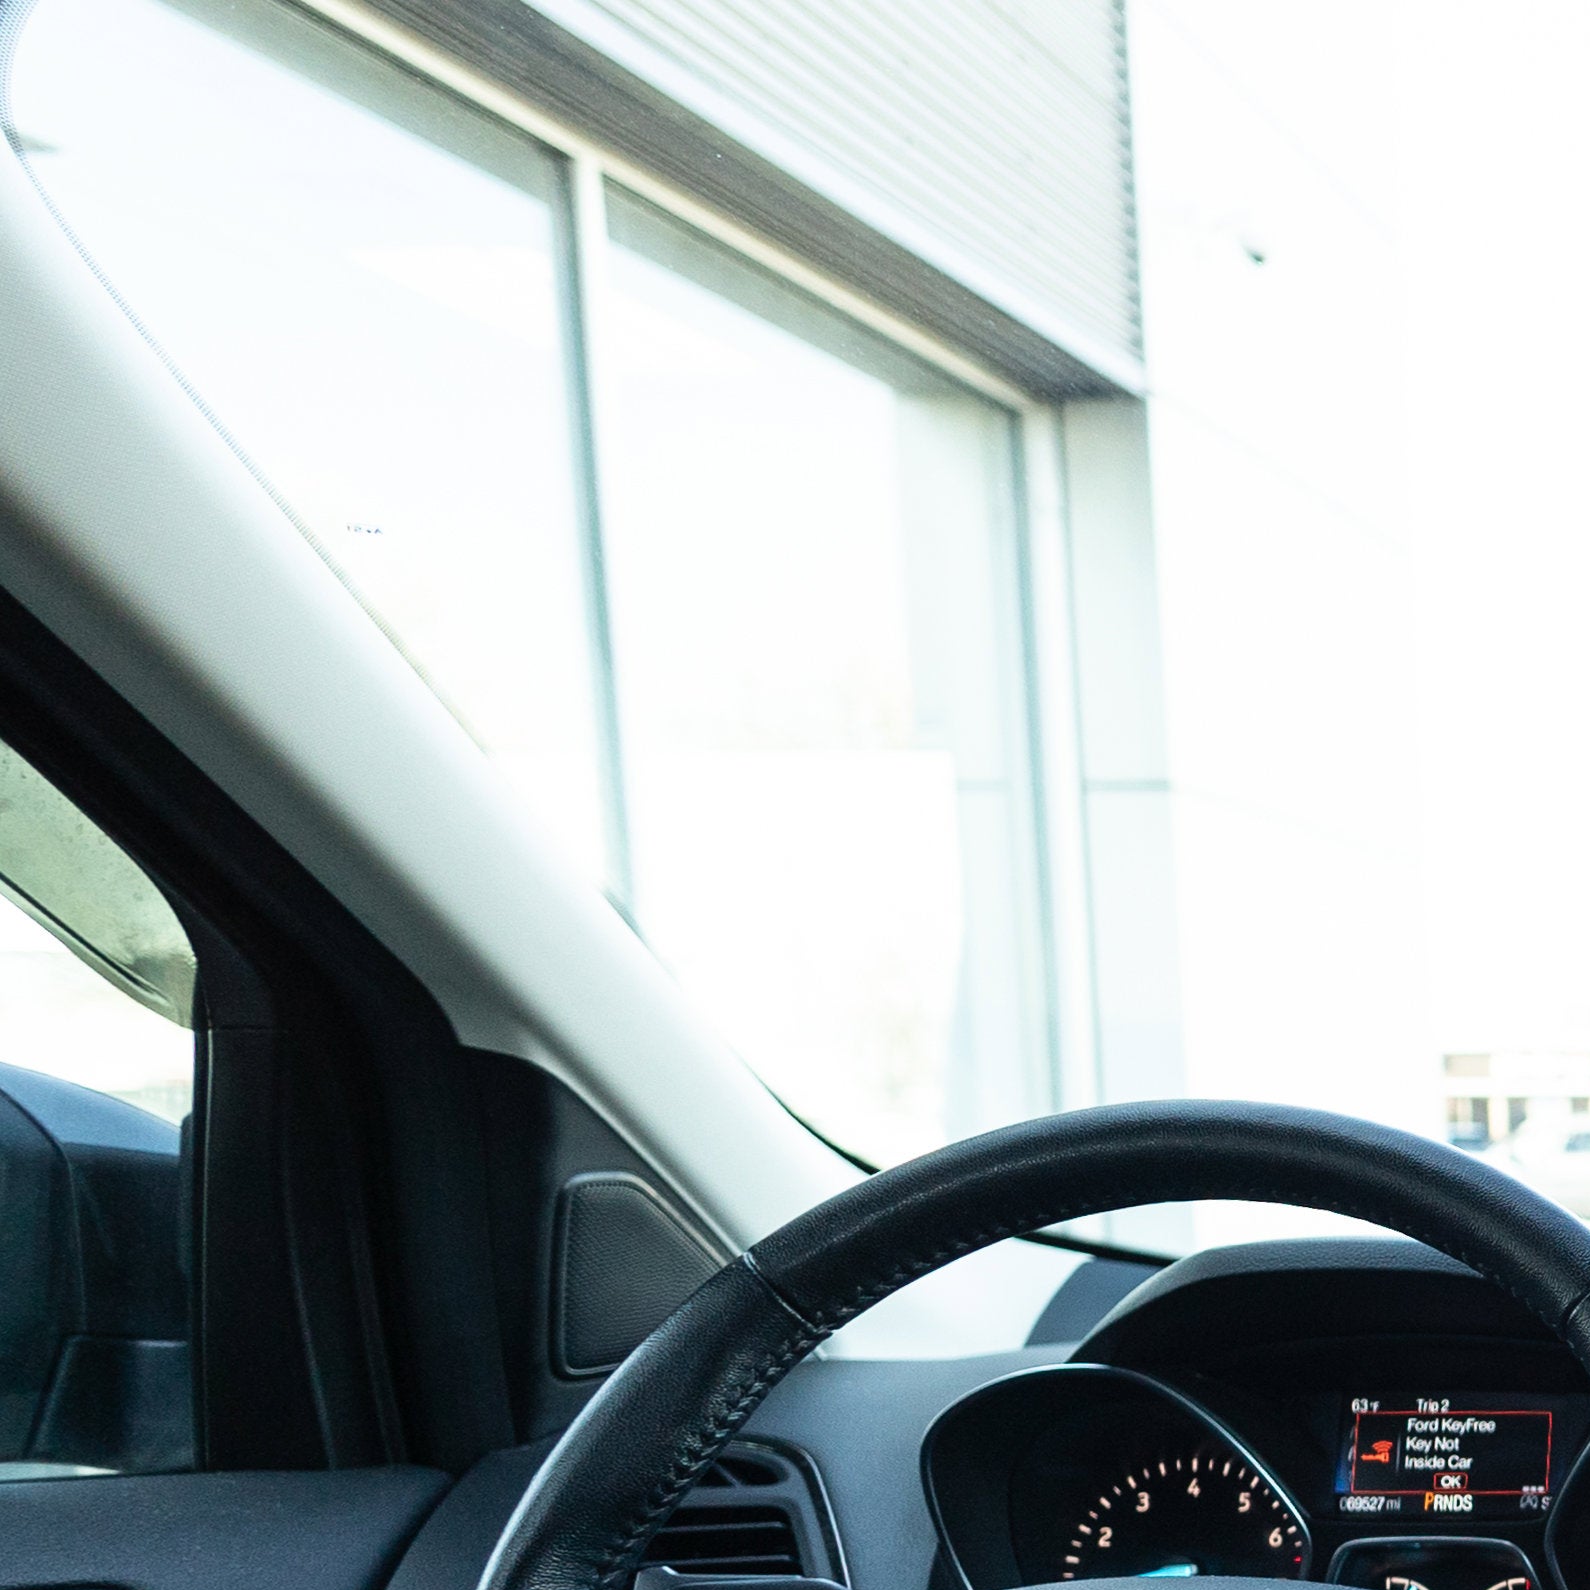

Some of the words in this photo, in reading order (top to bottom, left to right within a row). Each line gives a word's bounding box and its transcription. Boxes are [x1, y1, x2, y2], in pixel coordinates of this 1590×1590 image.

[1415, 1398, 1438, 1413] Trip
[1440, 1398, 1450, 1413] 2
[1407, 1418, 1439, 1432] Ford
[1441, 1417, 1496, 1434] KeyFree
[1405, 1436, 1432, 1453] Key
[1434, 1437, 1460, 1450] Not
[1404, 1455, 1446, 1469] Inside
[1449, 1454, 1473, 1469] Car
[1187, 1478, 1201, 1498] 4
[1439, 1475, 1462, 1488] OK
[1135, 1491, 1150, 1513] 3
[1238, 1491, 1251, 1513] 5
[1424, 1491, 1473, 1512] PRNDS
[1098, 1526, 1113, 1547] 2
[1268, 1528, 1283, 1548] 6
